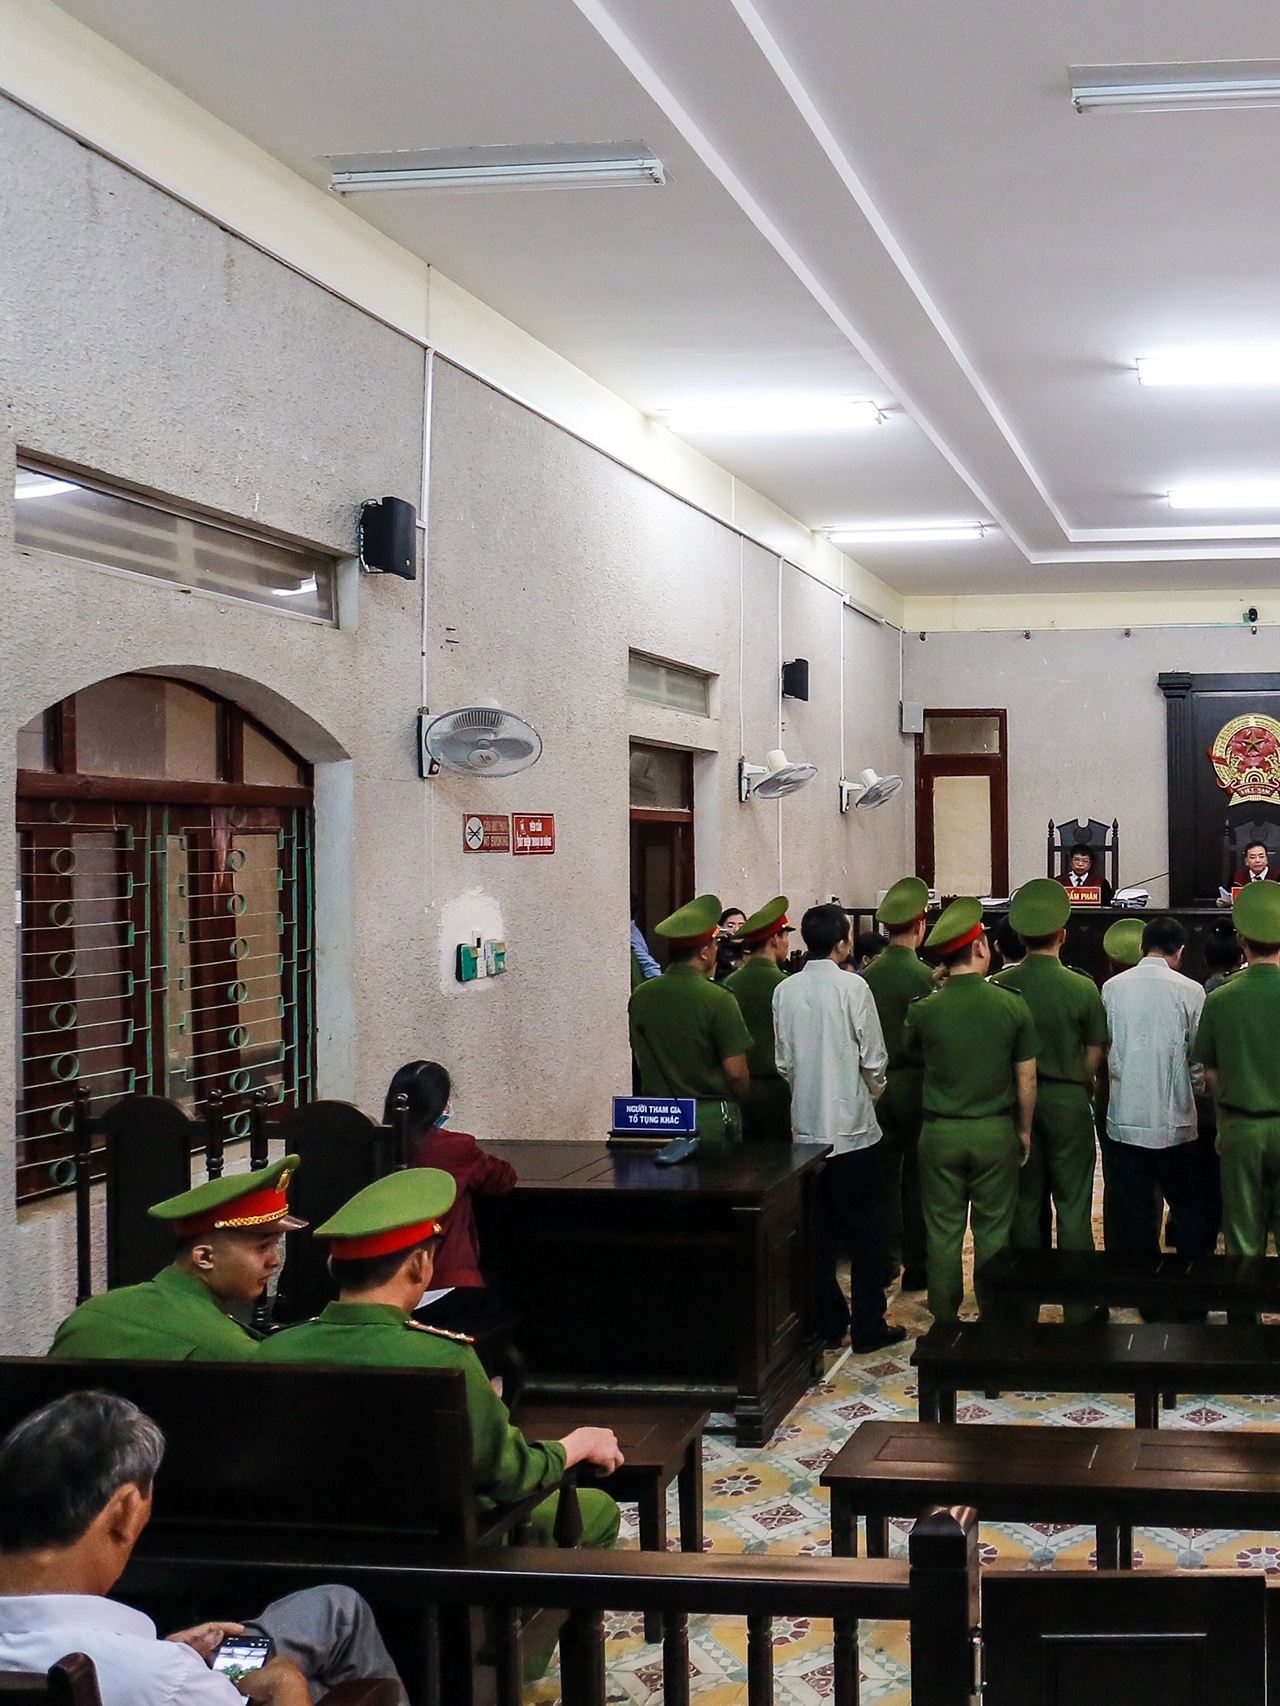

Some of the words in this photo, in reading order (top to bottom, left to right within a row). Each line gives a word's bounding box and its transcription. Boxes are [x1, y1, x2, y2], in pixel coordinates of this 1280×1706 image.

[626, 1104, 647, 1113] NGƯỜI
[649, 1105, 669, 1114] THAM
[670, 1106, 681, 1114] GIA
[628, 1114, 639, 1123] TỐ
[640, 1115, 659, 1125] TỤNG
[660, 1115, 680, 1124] KHÁC
